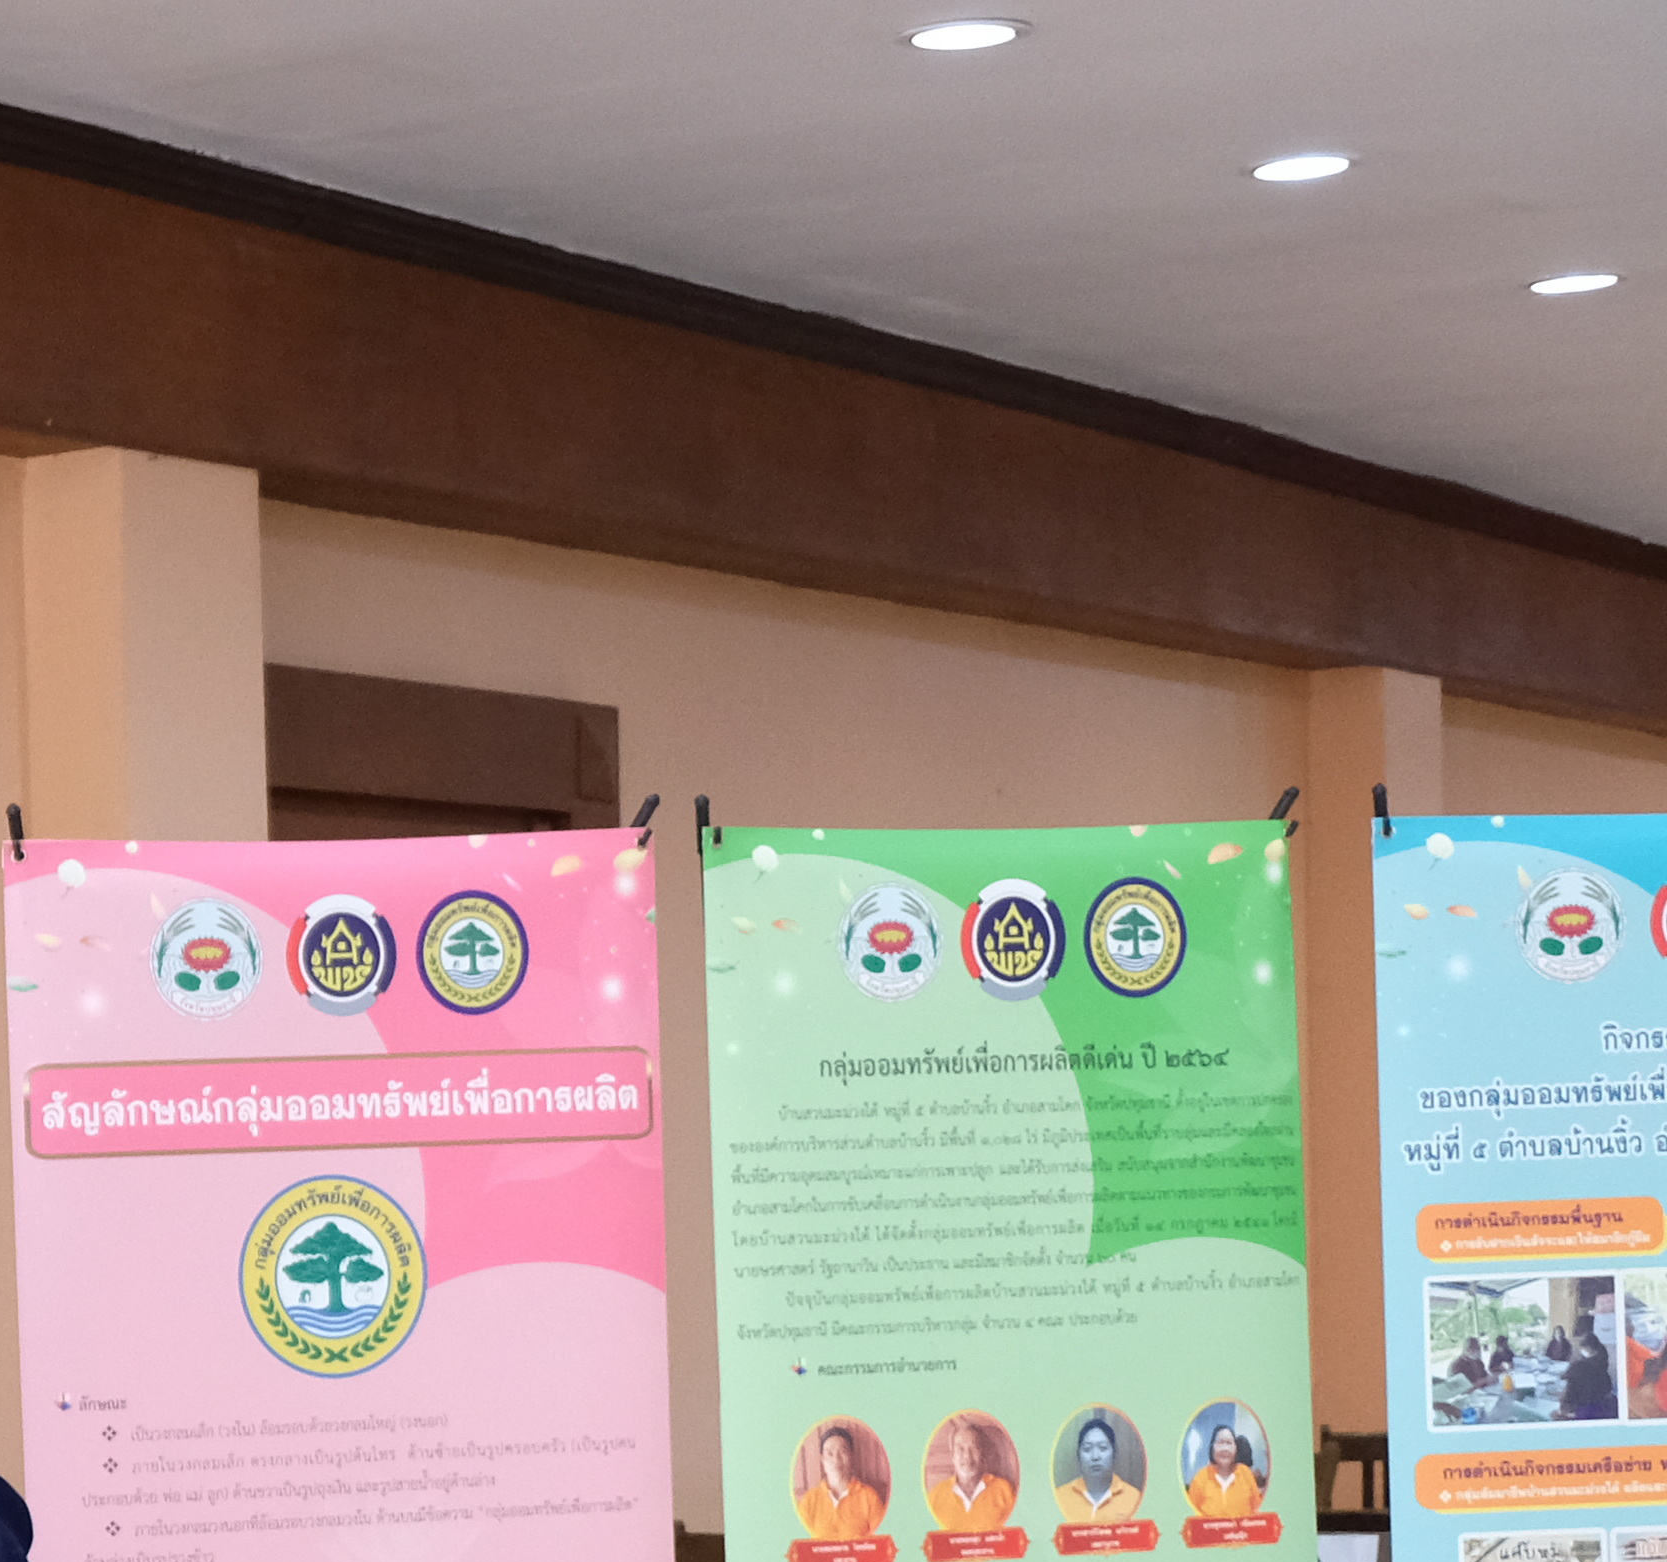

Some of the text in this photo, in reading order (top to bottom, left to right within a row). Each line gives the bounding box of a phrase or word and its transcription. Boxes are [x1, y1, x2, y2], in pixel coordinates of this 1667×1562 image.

[1603, 1023, 1667, 1051] กิจกร
[820, 1041, 1229, 1086] กลุ่มออมทรัพย์เพื่อการผลิตดีเด่น ปี ๒๕๖๔
[42, 1069, 638, 1137] สัญลักษณ์กลุ่มออมทรัพย์เพื่อการผลิต
[1405, 1125, 1461, 1171] หมู่ที่
[1499, 1119, 1643, 1157] ตำบลบ้านงิ้ว
[254, 1184, 412, 1271] กลุ่มออมทรัพย์เพื่อการผลิต
